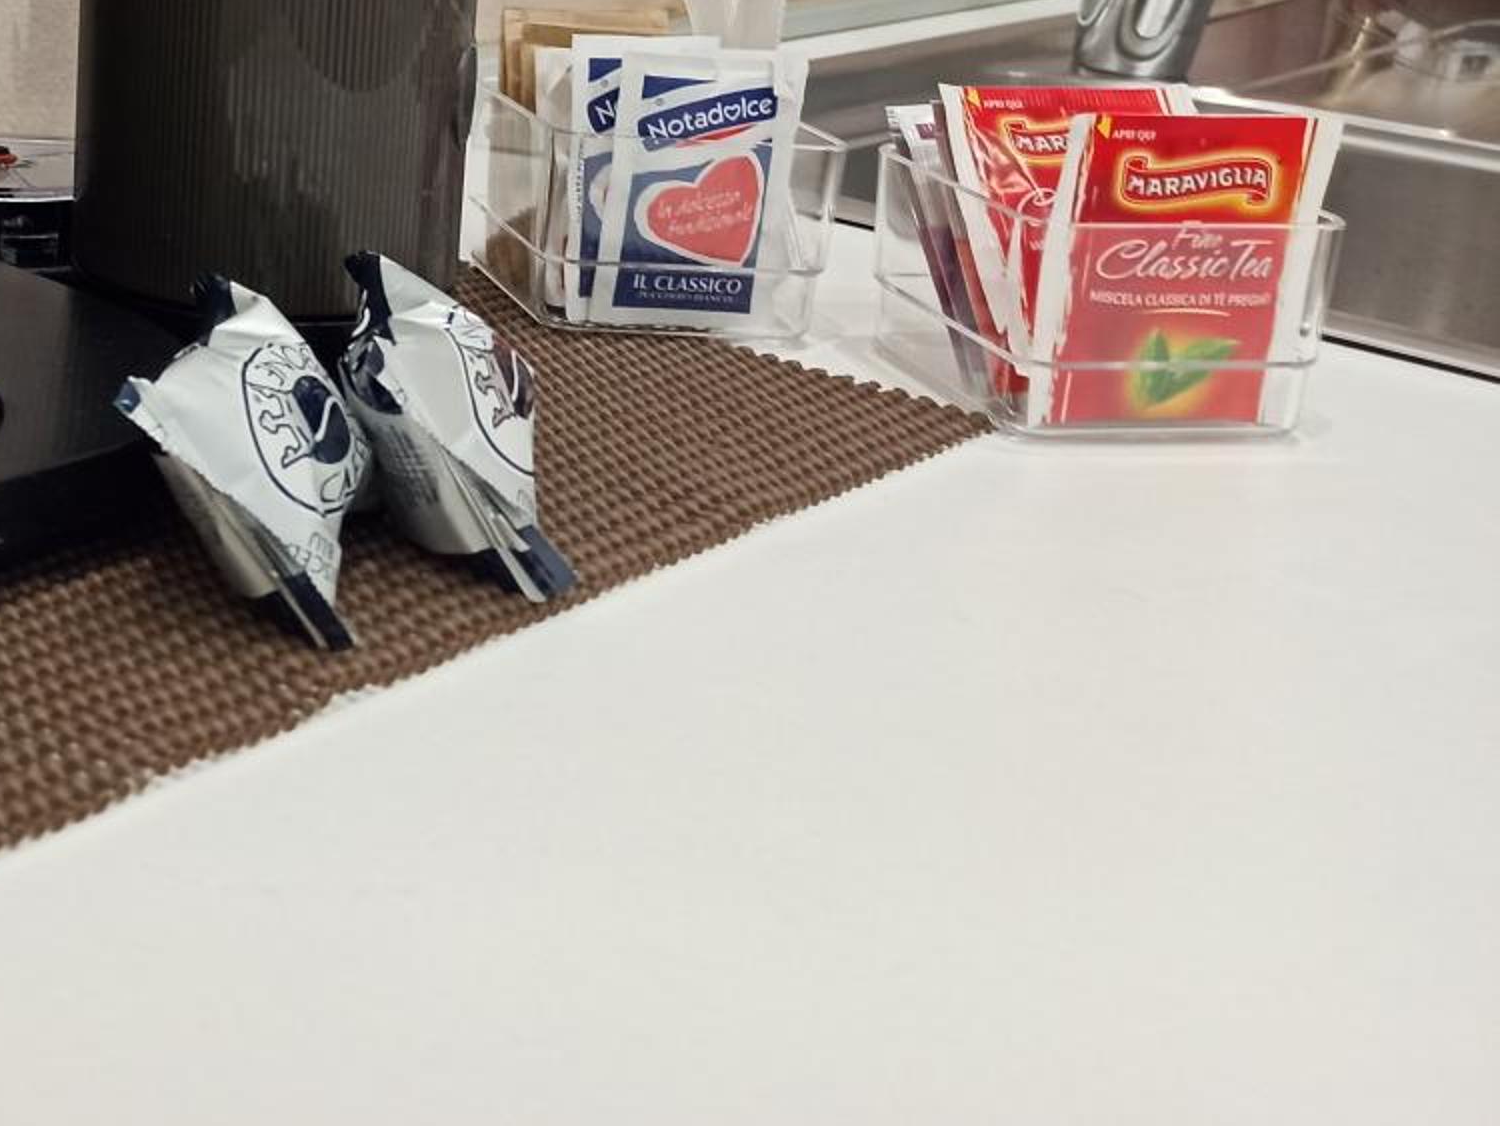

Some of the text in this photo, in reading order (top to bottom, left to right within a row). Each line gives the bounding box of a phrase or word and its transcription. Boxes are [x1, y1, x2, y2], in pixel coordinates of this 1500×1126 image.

[647, 96, 773, 145] Notadolce
[1128, 166, 1268, 196] MARAVIGLIA
[1096, 239, 1229, 281] Classic
[654, 275, 743, 296] CLASSICO
